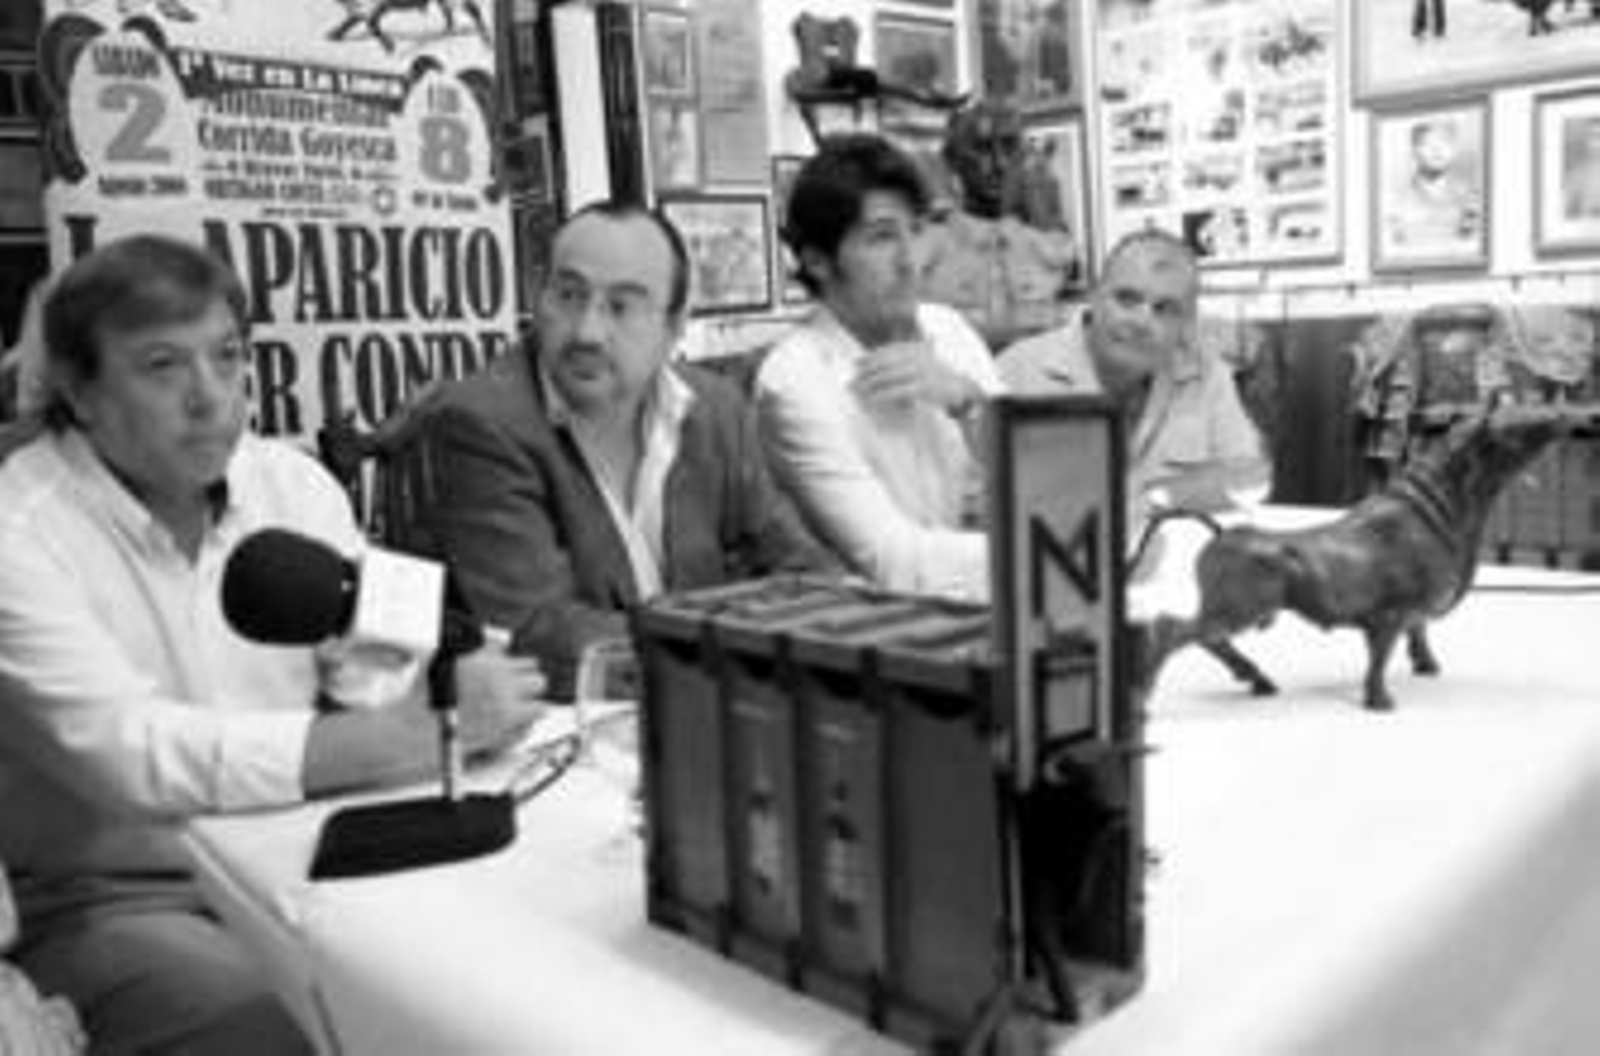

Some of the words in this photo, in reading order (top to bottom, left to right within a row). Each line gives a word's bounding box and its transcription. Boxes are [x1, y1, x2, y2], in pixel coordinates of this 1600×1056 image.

[97, 83, 171, 164] 2
[197, 116, 295, 157] Corrida
[417, 115, 472, 186] 8
